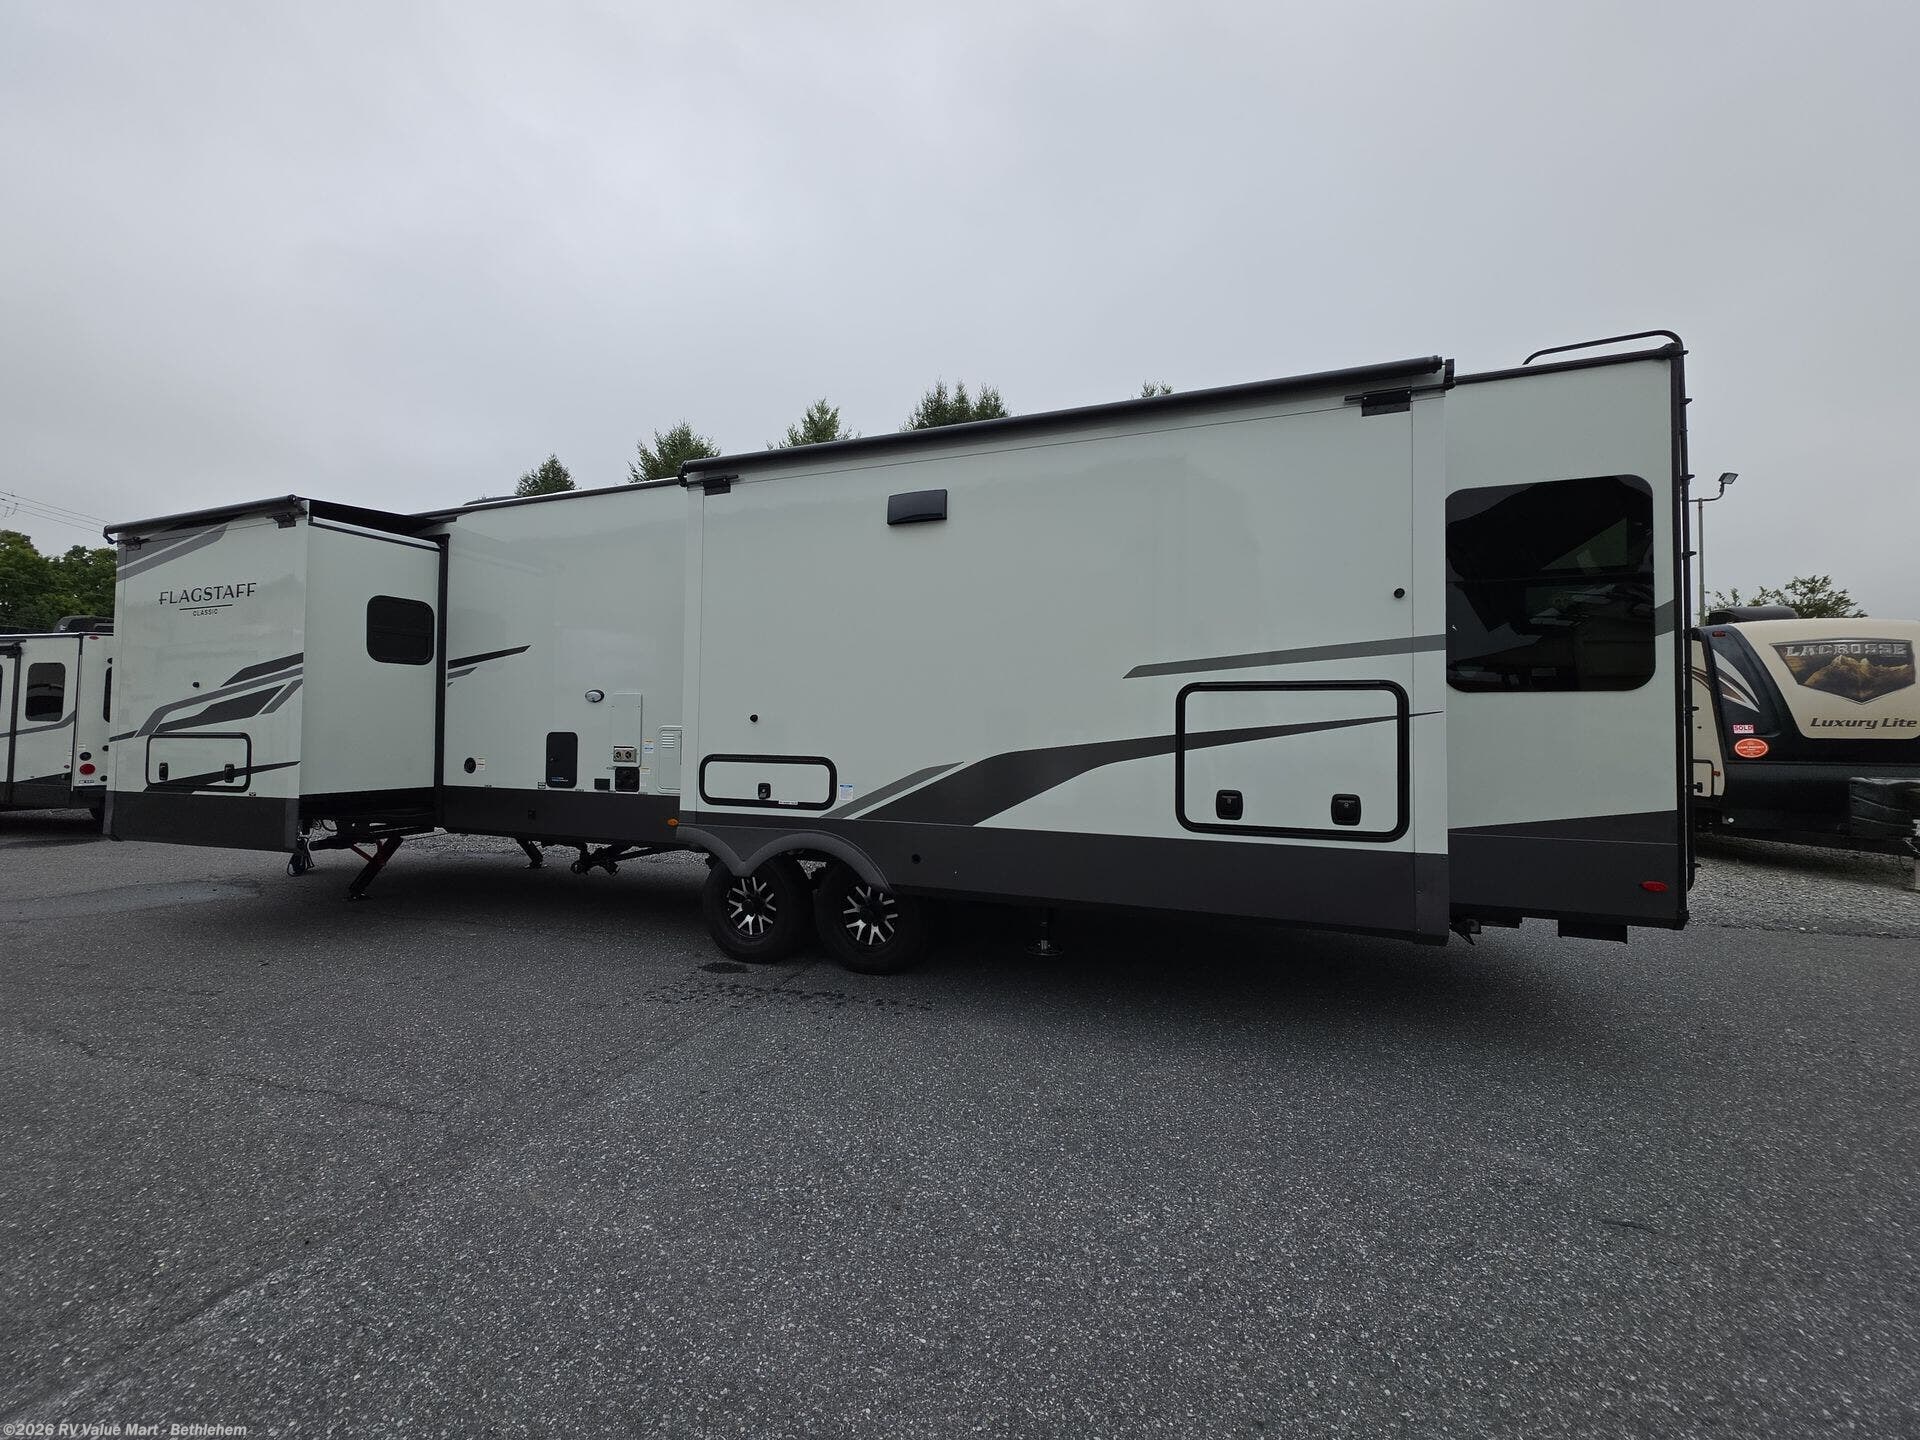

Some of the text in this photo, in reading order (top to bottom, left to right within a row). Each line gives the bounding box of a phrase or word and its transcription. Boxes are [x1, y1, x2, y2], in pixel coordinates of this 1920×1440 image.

[159, 582, 257, 605] FLAGSTAFF
[192, 608, 218, 617] CLASSIC
[1785, 643, 1908, 657] LACROSSE
[1810, 717, 1918, 730] Luxury Lite
